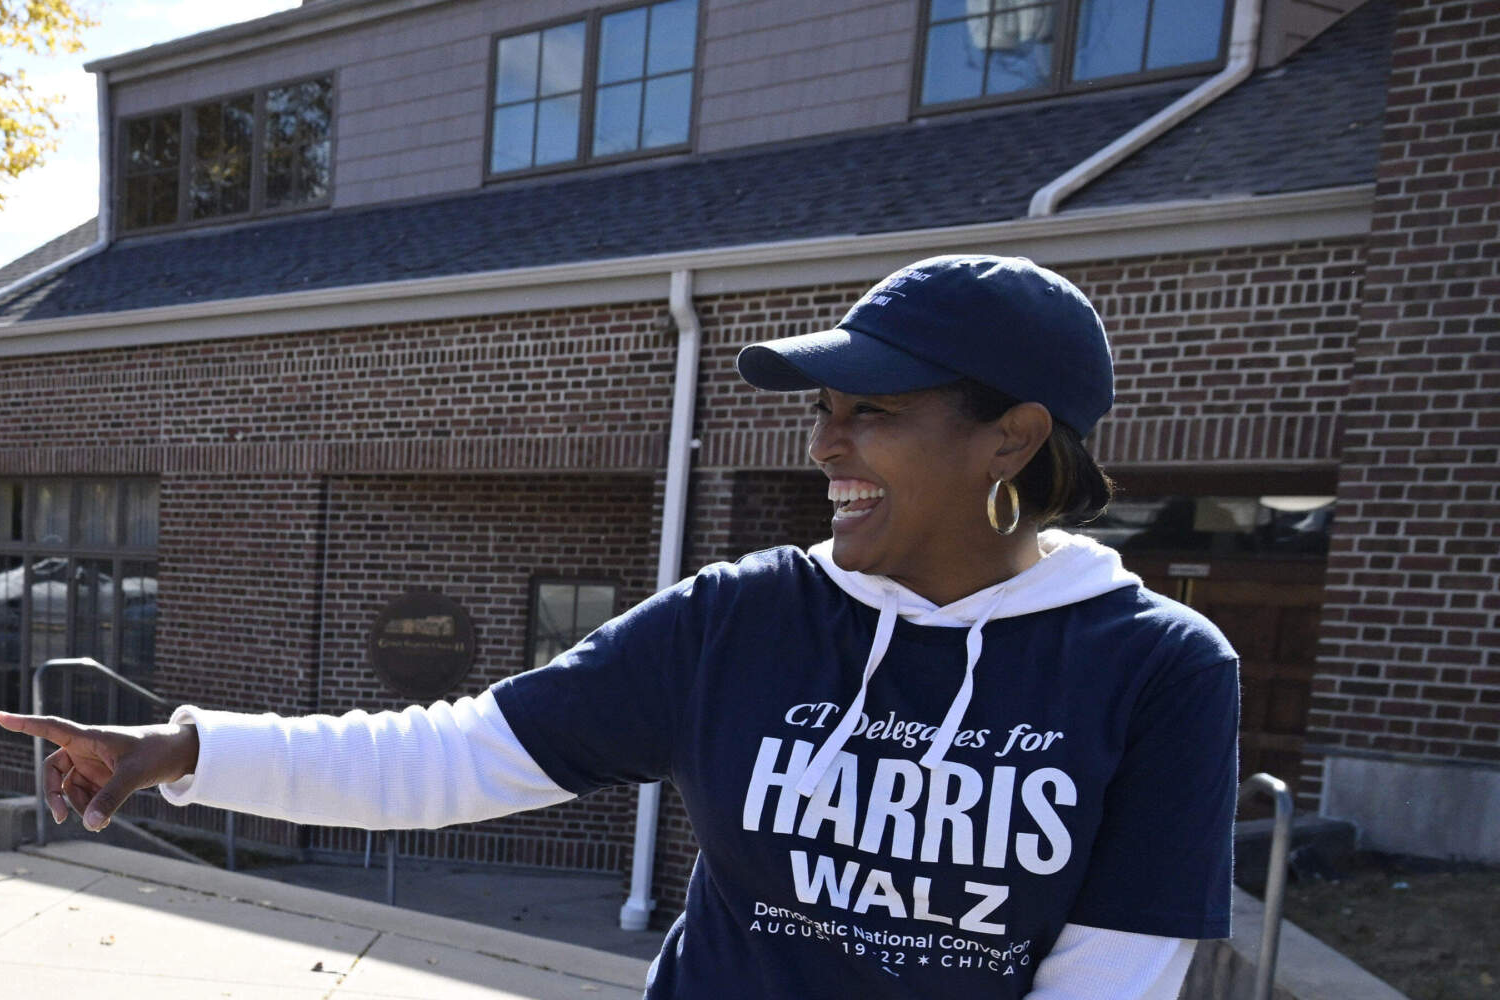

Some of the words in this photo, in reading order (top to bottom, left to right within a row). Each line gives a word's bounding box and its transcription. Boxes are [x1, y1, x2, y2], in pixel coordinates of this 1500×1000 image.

[785, 702, 840, 729] CT
[851, 711, 990, 749] Delegaes
[994, 723, 1064, 758] for
[742, 736, 1078, 876] HARRIS
[790, 850, 1010, 936] WALZ
[749, 920, 831, 942] AUGUS
[941, 954, 1030, 977] CHICAO
[852, 924, 933, 949] National
[939, 934, 1031, 962] Convenion
